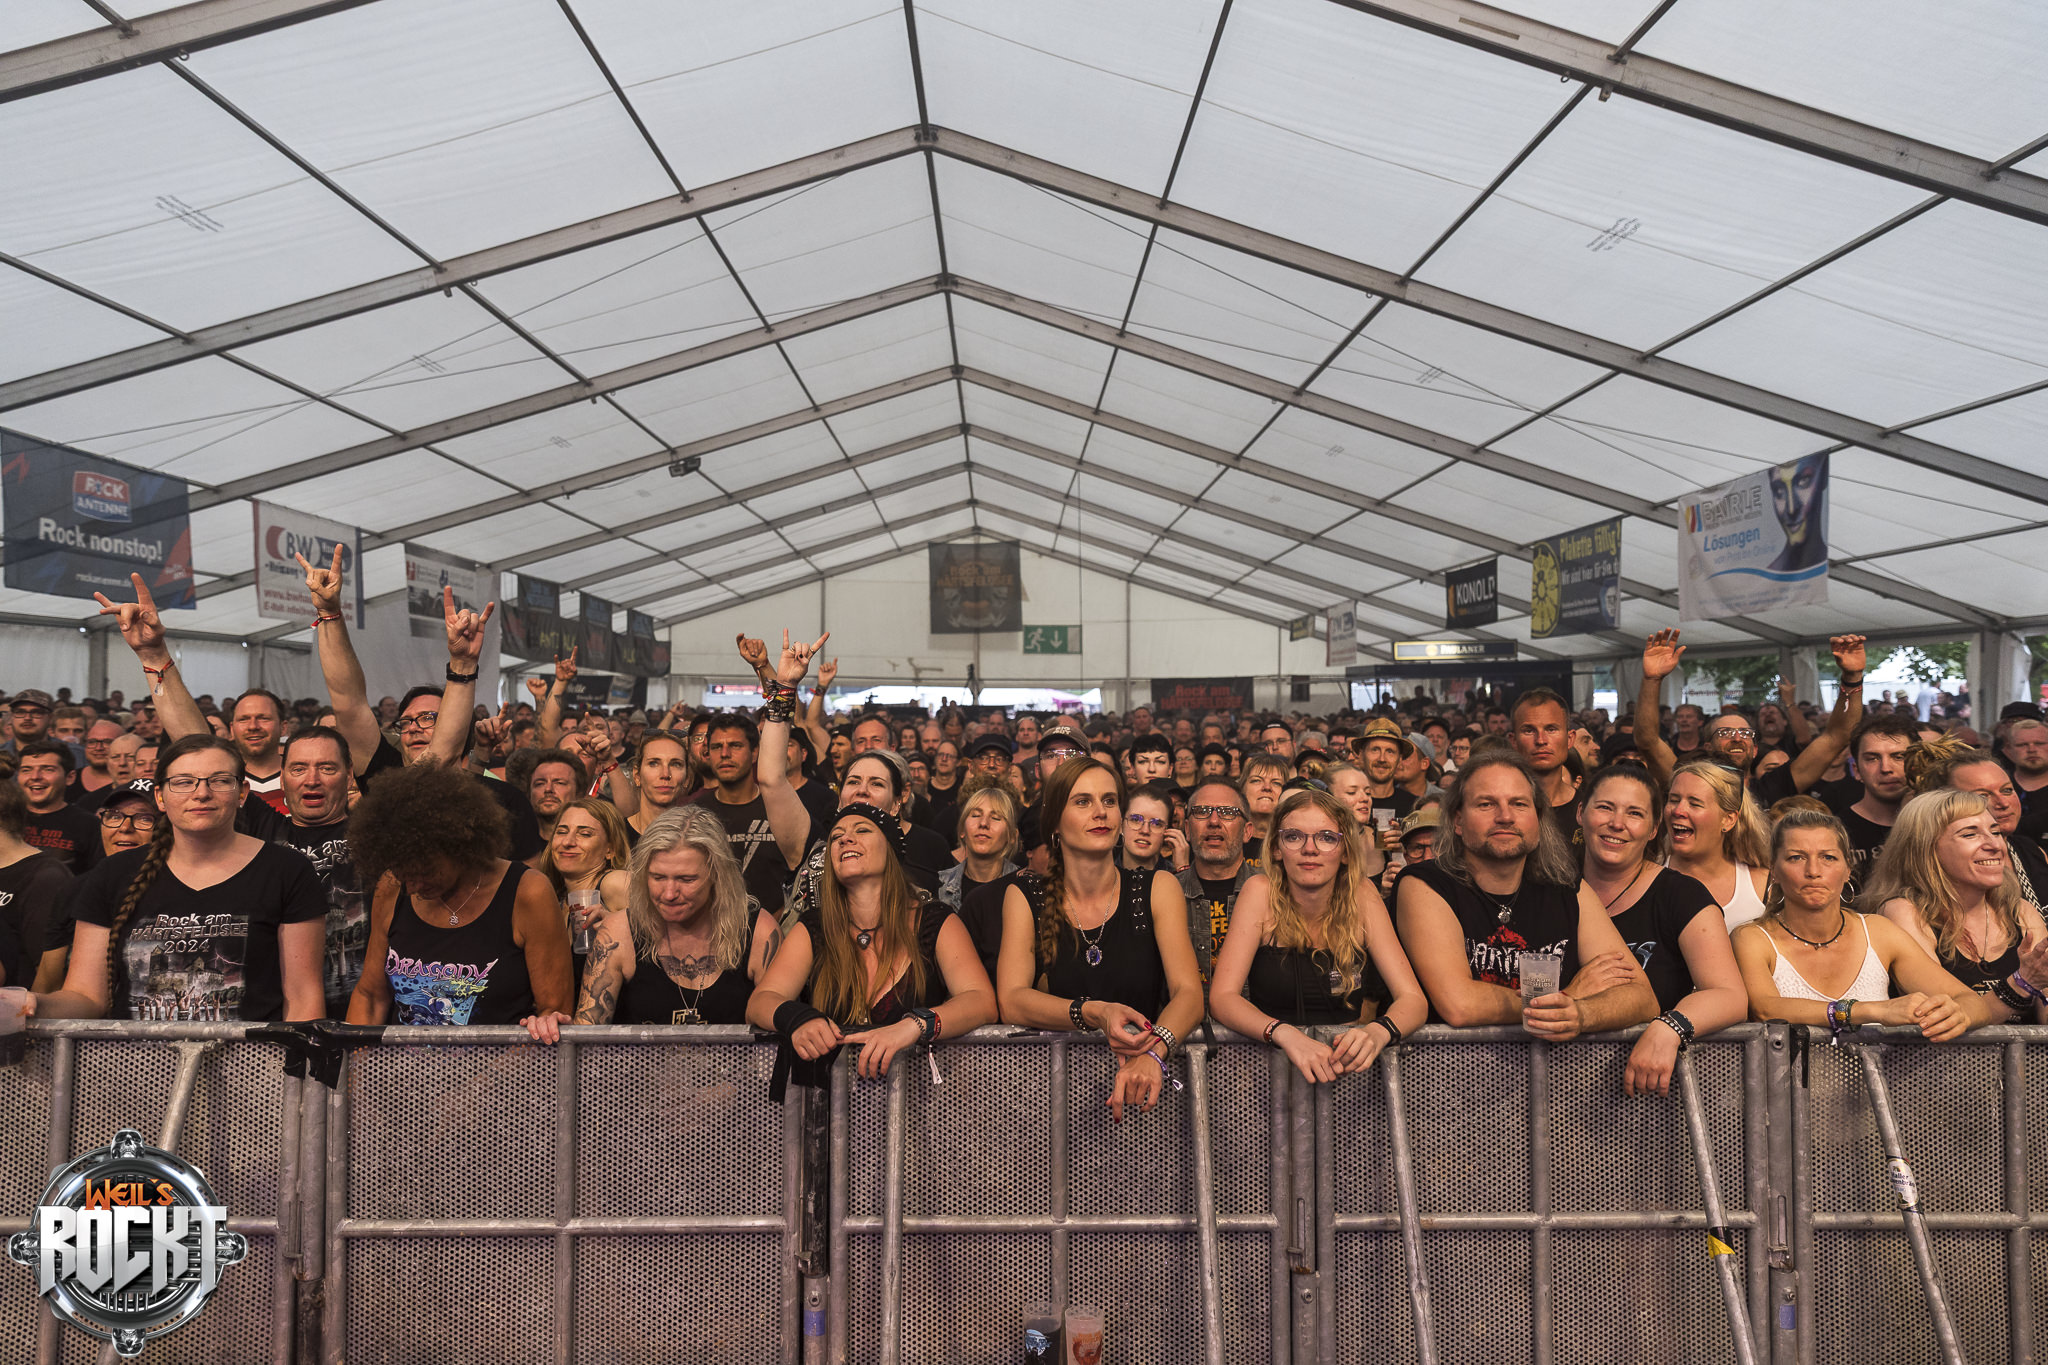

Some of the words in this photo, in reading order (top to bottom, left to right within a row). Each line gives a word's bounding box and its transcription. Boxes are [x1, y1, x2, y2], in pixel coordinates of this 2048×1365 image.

[76, 496, 129, 517] ANTENNE
[38, 517, 87, 549] Rock
[89, 534, 163, 564] nonstop!
[1560, 535, 1592, 563] Plakette
[1703, 527, 1761, 552] Lösungen
[1175, 684, 1206, 698] Rock
[1210, 685, 1232, 697] am
[41, 829, 64, 838] am
[727, 833, 776, 843] MSTEIN
[155, 913, 202, 928] Rock
[204, 913, 233, 925] am
[129, 922, 249, 941] HÄRTSFELDSEE
[163, 938, 211, 955] 2024
[384, 946, 499, 985] DRAGONY
